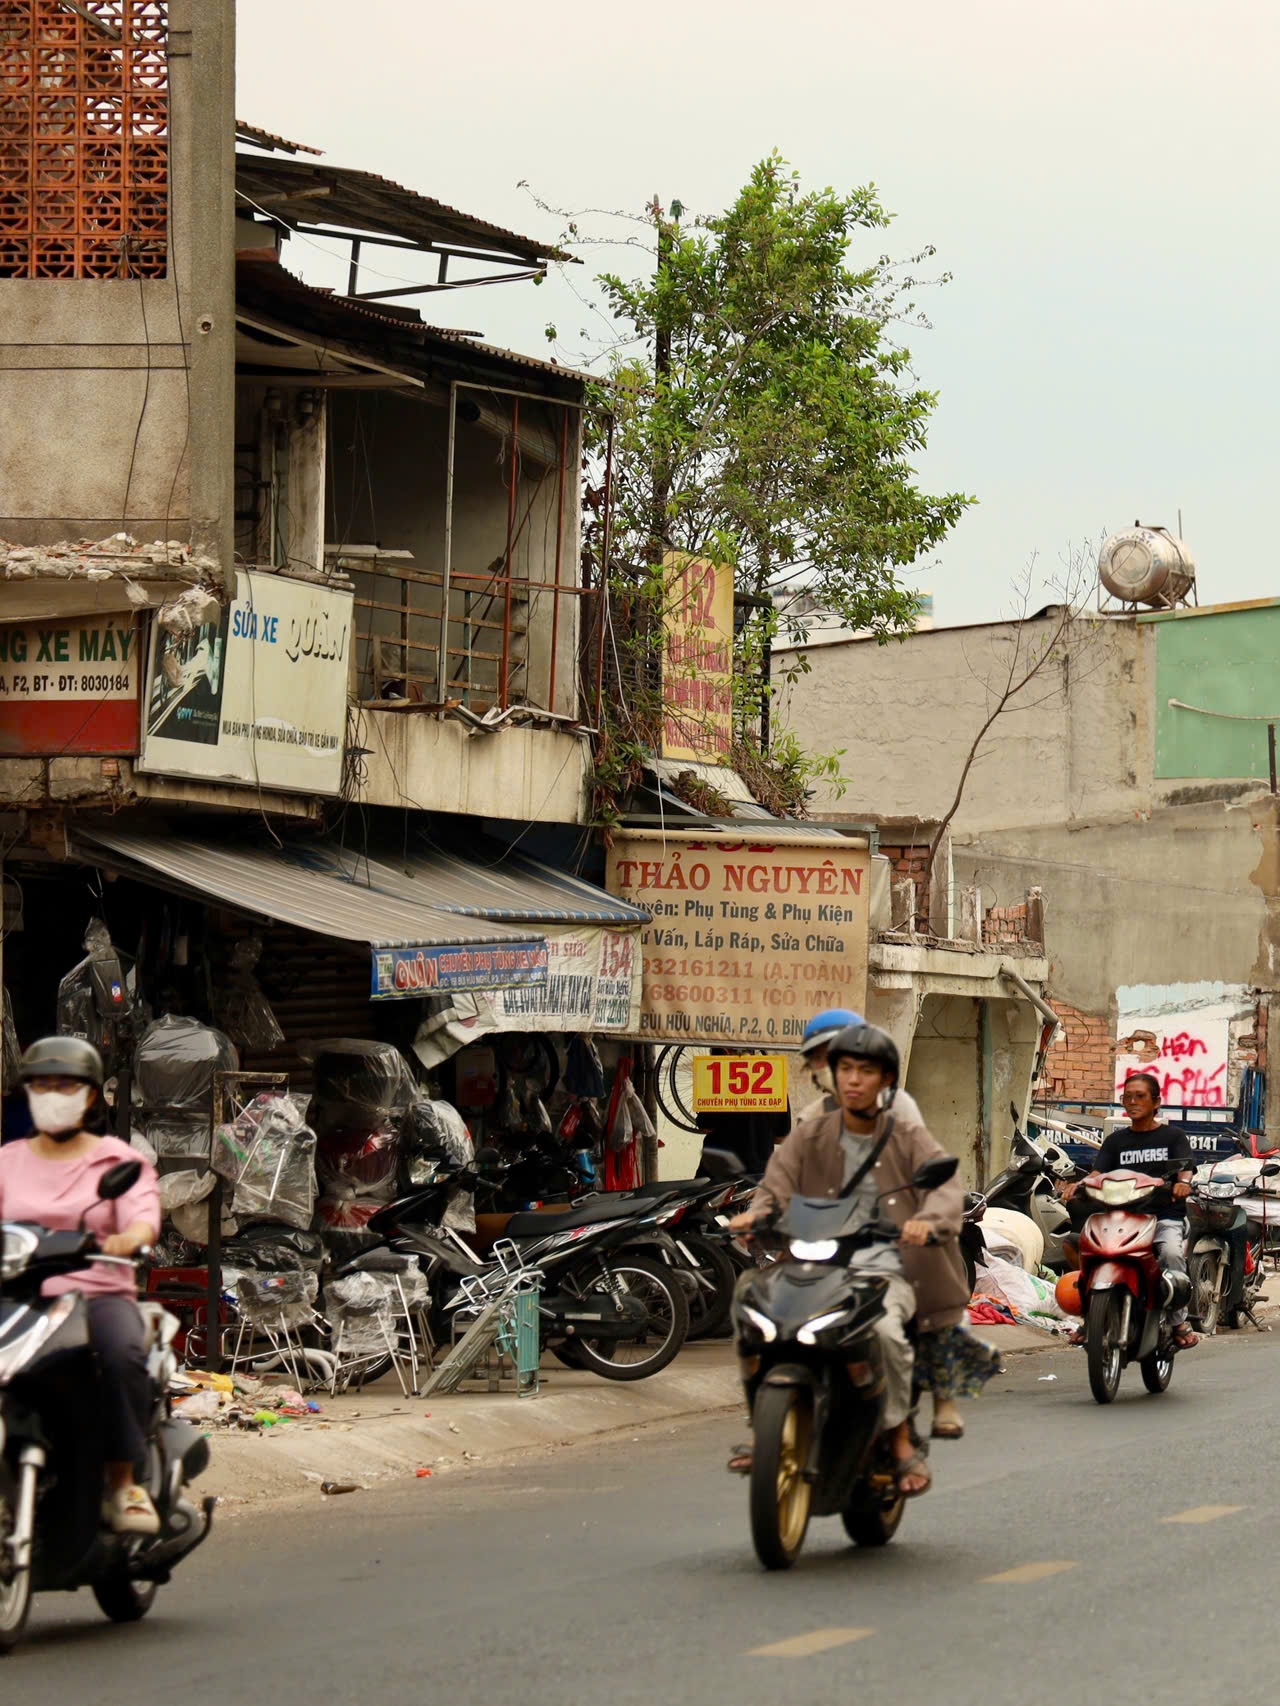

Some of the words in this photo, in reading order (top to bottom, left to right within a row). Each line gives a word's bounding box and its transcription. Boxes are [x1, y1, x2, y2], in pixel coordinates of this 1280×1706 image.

[36, 630, 70, 662] XE
[79, 621, 134, 662] MÁY
[261, 616, 279, 643] XE
[13, 676, 29, 695] F2,
[33, 676, 48, 691] BT
[81, 675, 129, 691] 8030184
[616, 852, 710, 891] THẢO
[723, 860, 864, 896] NGUYÊN
[685, 900, 713, 918] Phụ
[720, 901, 759, 922] Tùng
[764, 904, 777, 919] &
[783, 904, 811, 924] Phụ
[818, 905, 853, 923] Kiện
[654, 927, 689, 949] Vấn,
[695, 928, 724, 952] Lắp
[730, 931, 765, 952] Ráp,
[771, 932, 800, 951] Sửa
[805, 934, 844, 952] Chữa
[395, 955, 440, 990] QUÂN
[516, 950, 529, 969] XE
[763, 985, 797, 1007] (CÔ
[640, 1010, 661, 1030] BÙI
[666, 1011, 691, 1031] HỮU
[695, 1013, 735, 1036] NGHĨA,
[740, 1017, 762, 1038] P.2,
[766, 1018, 778, 1038] Q.
[783, 1015, 808, 1036] BÌN
[1157, 1031, 1207, 1062] Hận
[706, 1061, 774, 1094] 152
[697, 1096, 723, 1106] CHUYÊN
[725, 1097, 738, 1108] PHỤ
[740, 1096, 757, 1106] TÙNG
[759, 1098, 767, 1106] XE
[1120, 1147, 1169, 1165] CONVERSE
[1186, 1136, 1217, 1151] 8141
